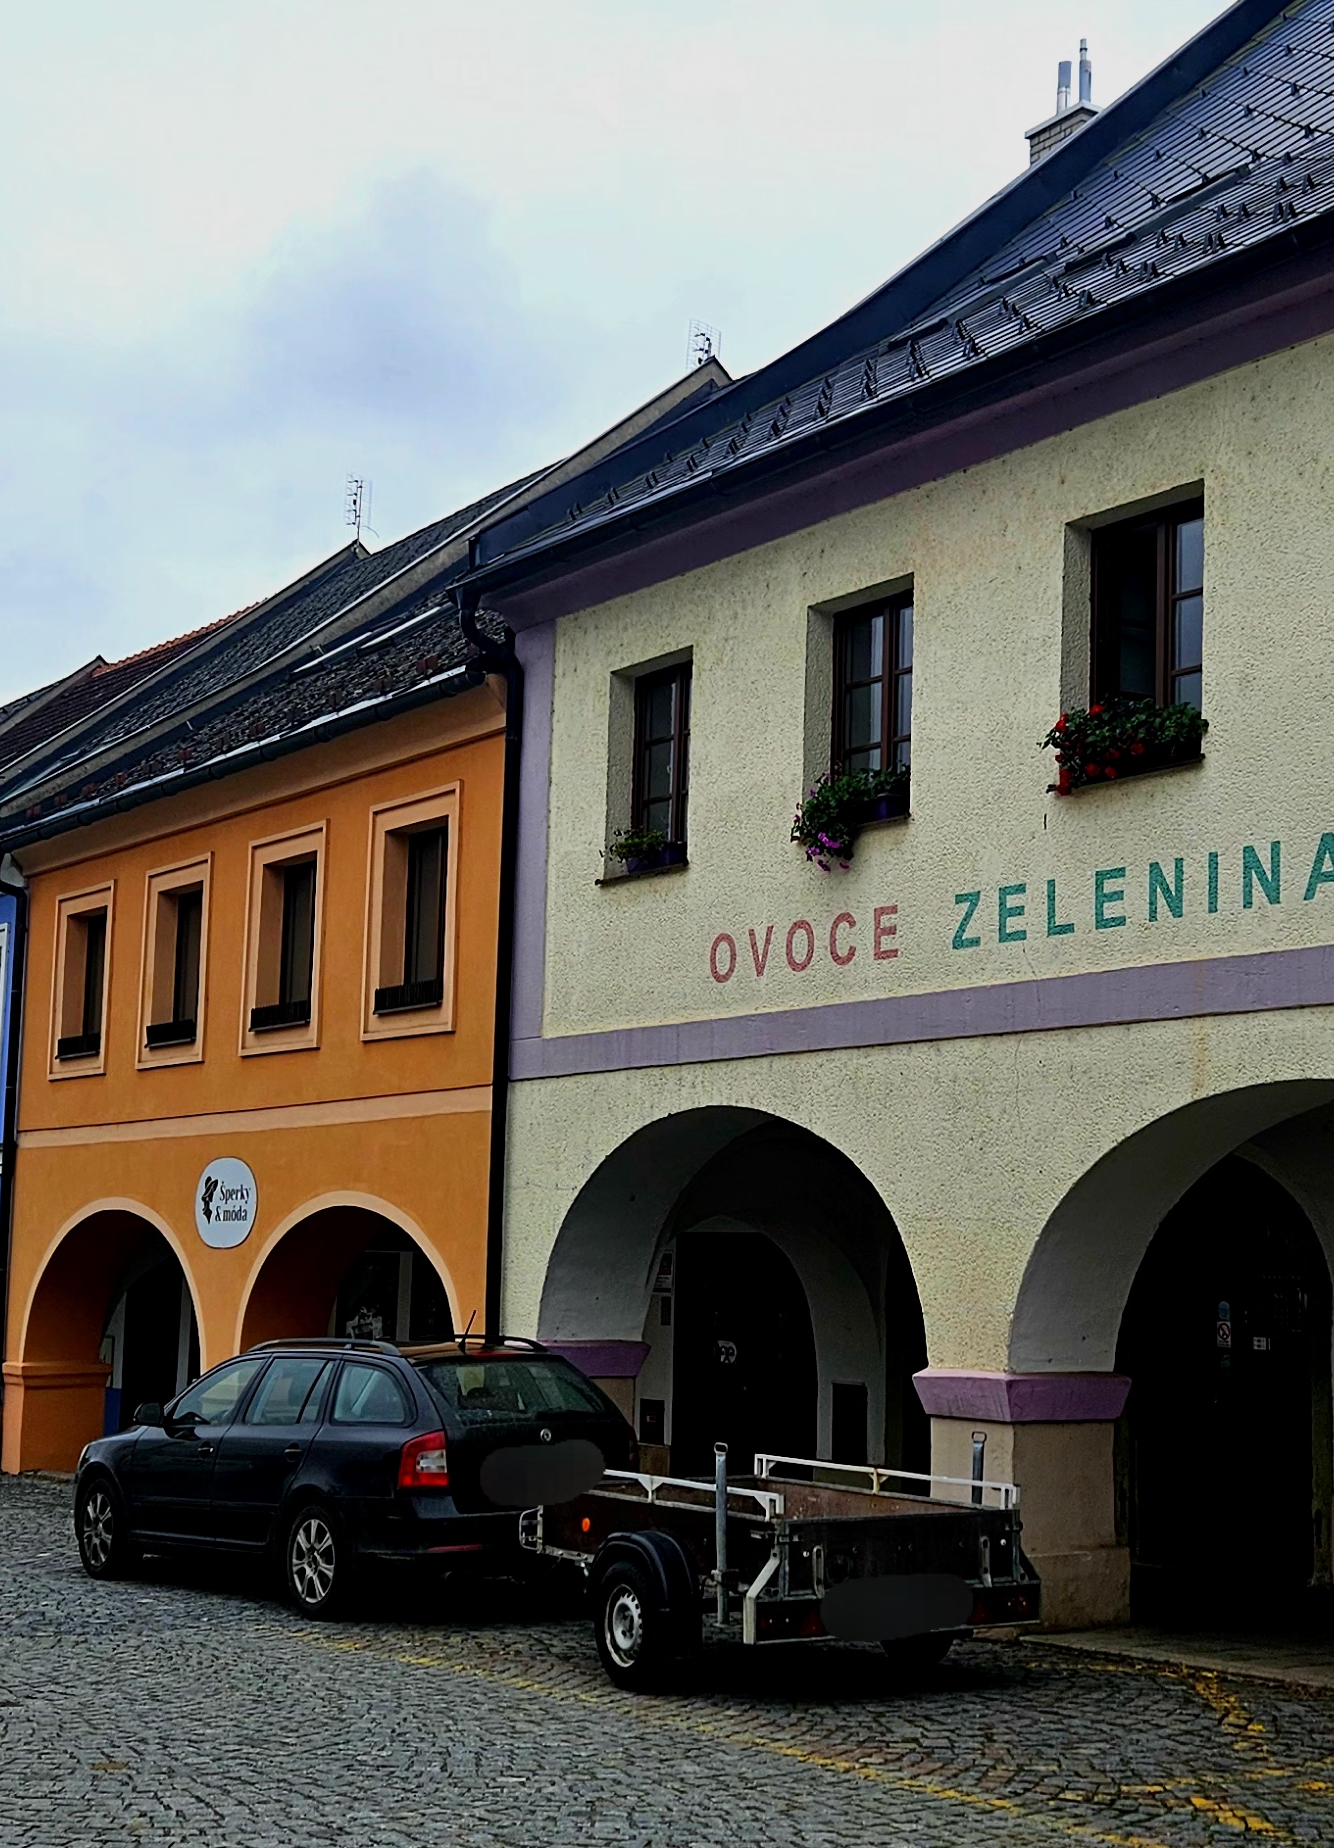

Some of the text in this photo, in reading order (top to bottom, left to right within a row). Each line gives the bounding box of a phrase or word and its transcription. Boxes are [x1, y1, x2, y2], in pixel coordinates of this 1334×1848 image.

[709, 904, 899, 984] OVOCE
[219, 1181, 251, 1204] Šperky
[215, 1204, 247, 1222] & móda
